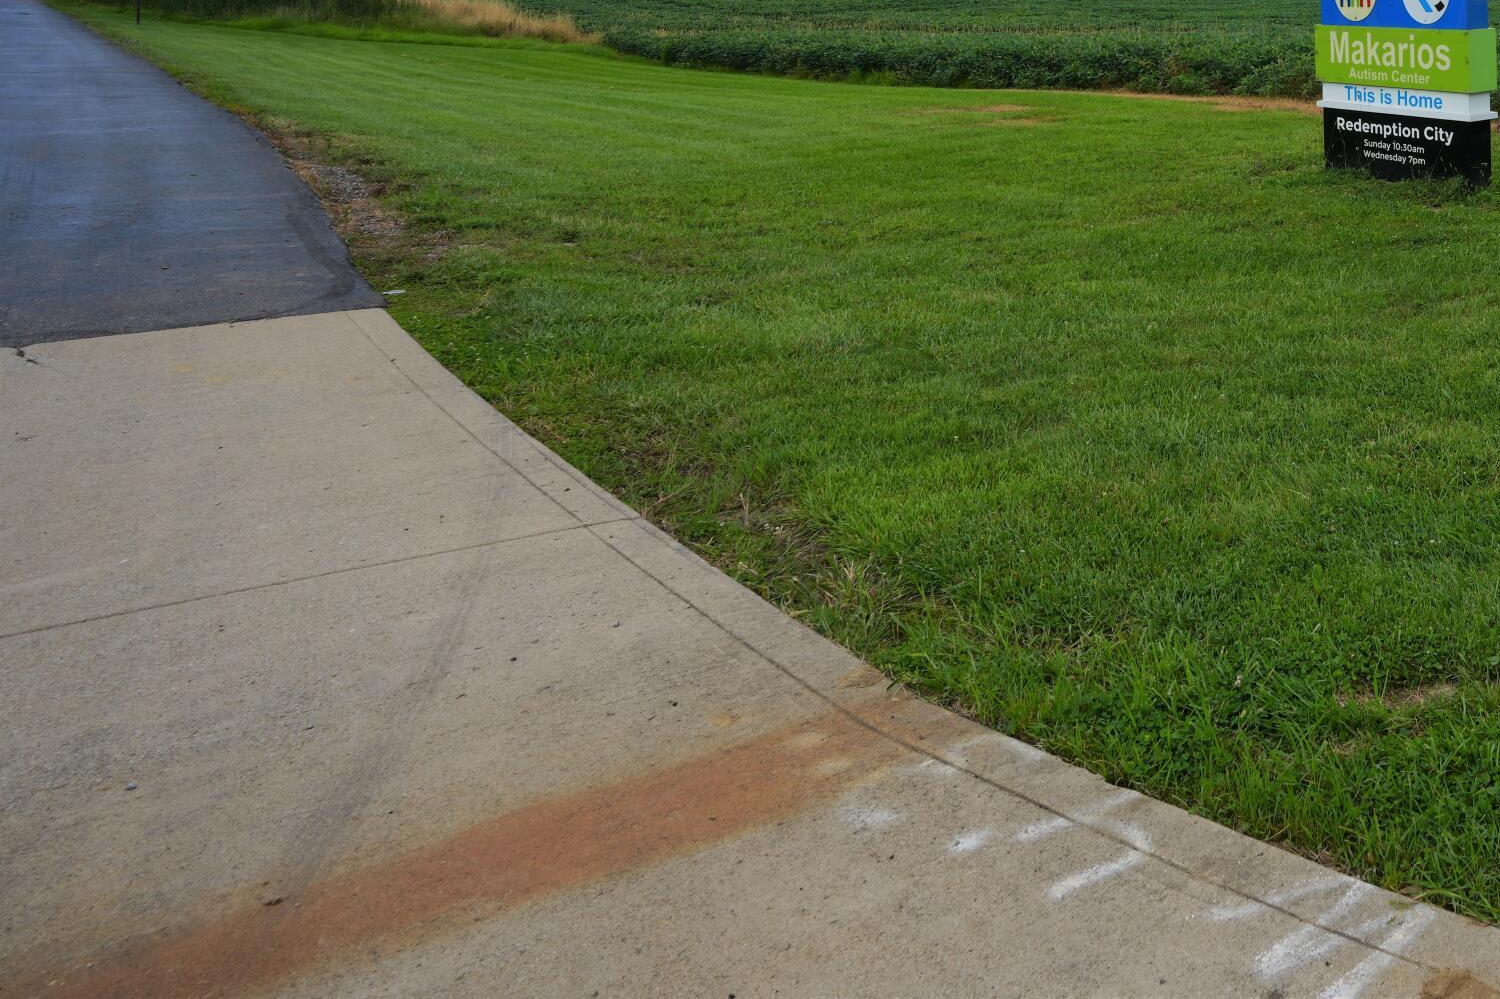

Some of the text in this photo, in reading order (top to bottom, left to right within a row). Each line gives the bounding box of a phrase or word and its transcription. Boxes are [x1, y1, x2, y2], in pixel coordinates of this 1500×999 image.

[1330, 31, 1450, 70] Makarios
[1349, 68, 1431, 85] Autism Center
[1344, 85, 1443, 110] This is Home
[1336, 117, 1454, 146] Redemption City
[1363, 138, 1425, 154] Sunday 10:30am
[1363, 150, 1426, 166] Wednesday 7pm
